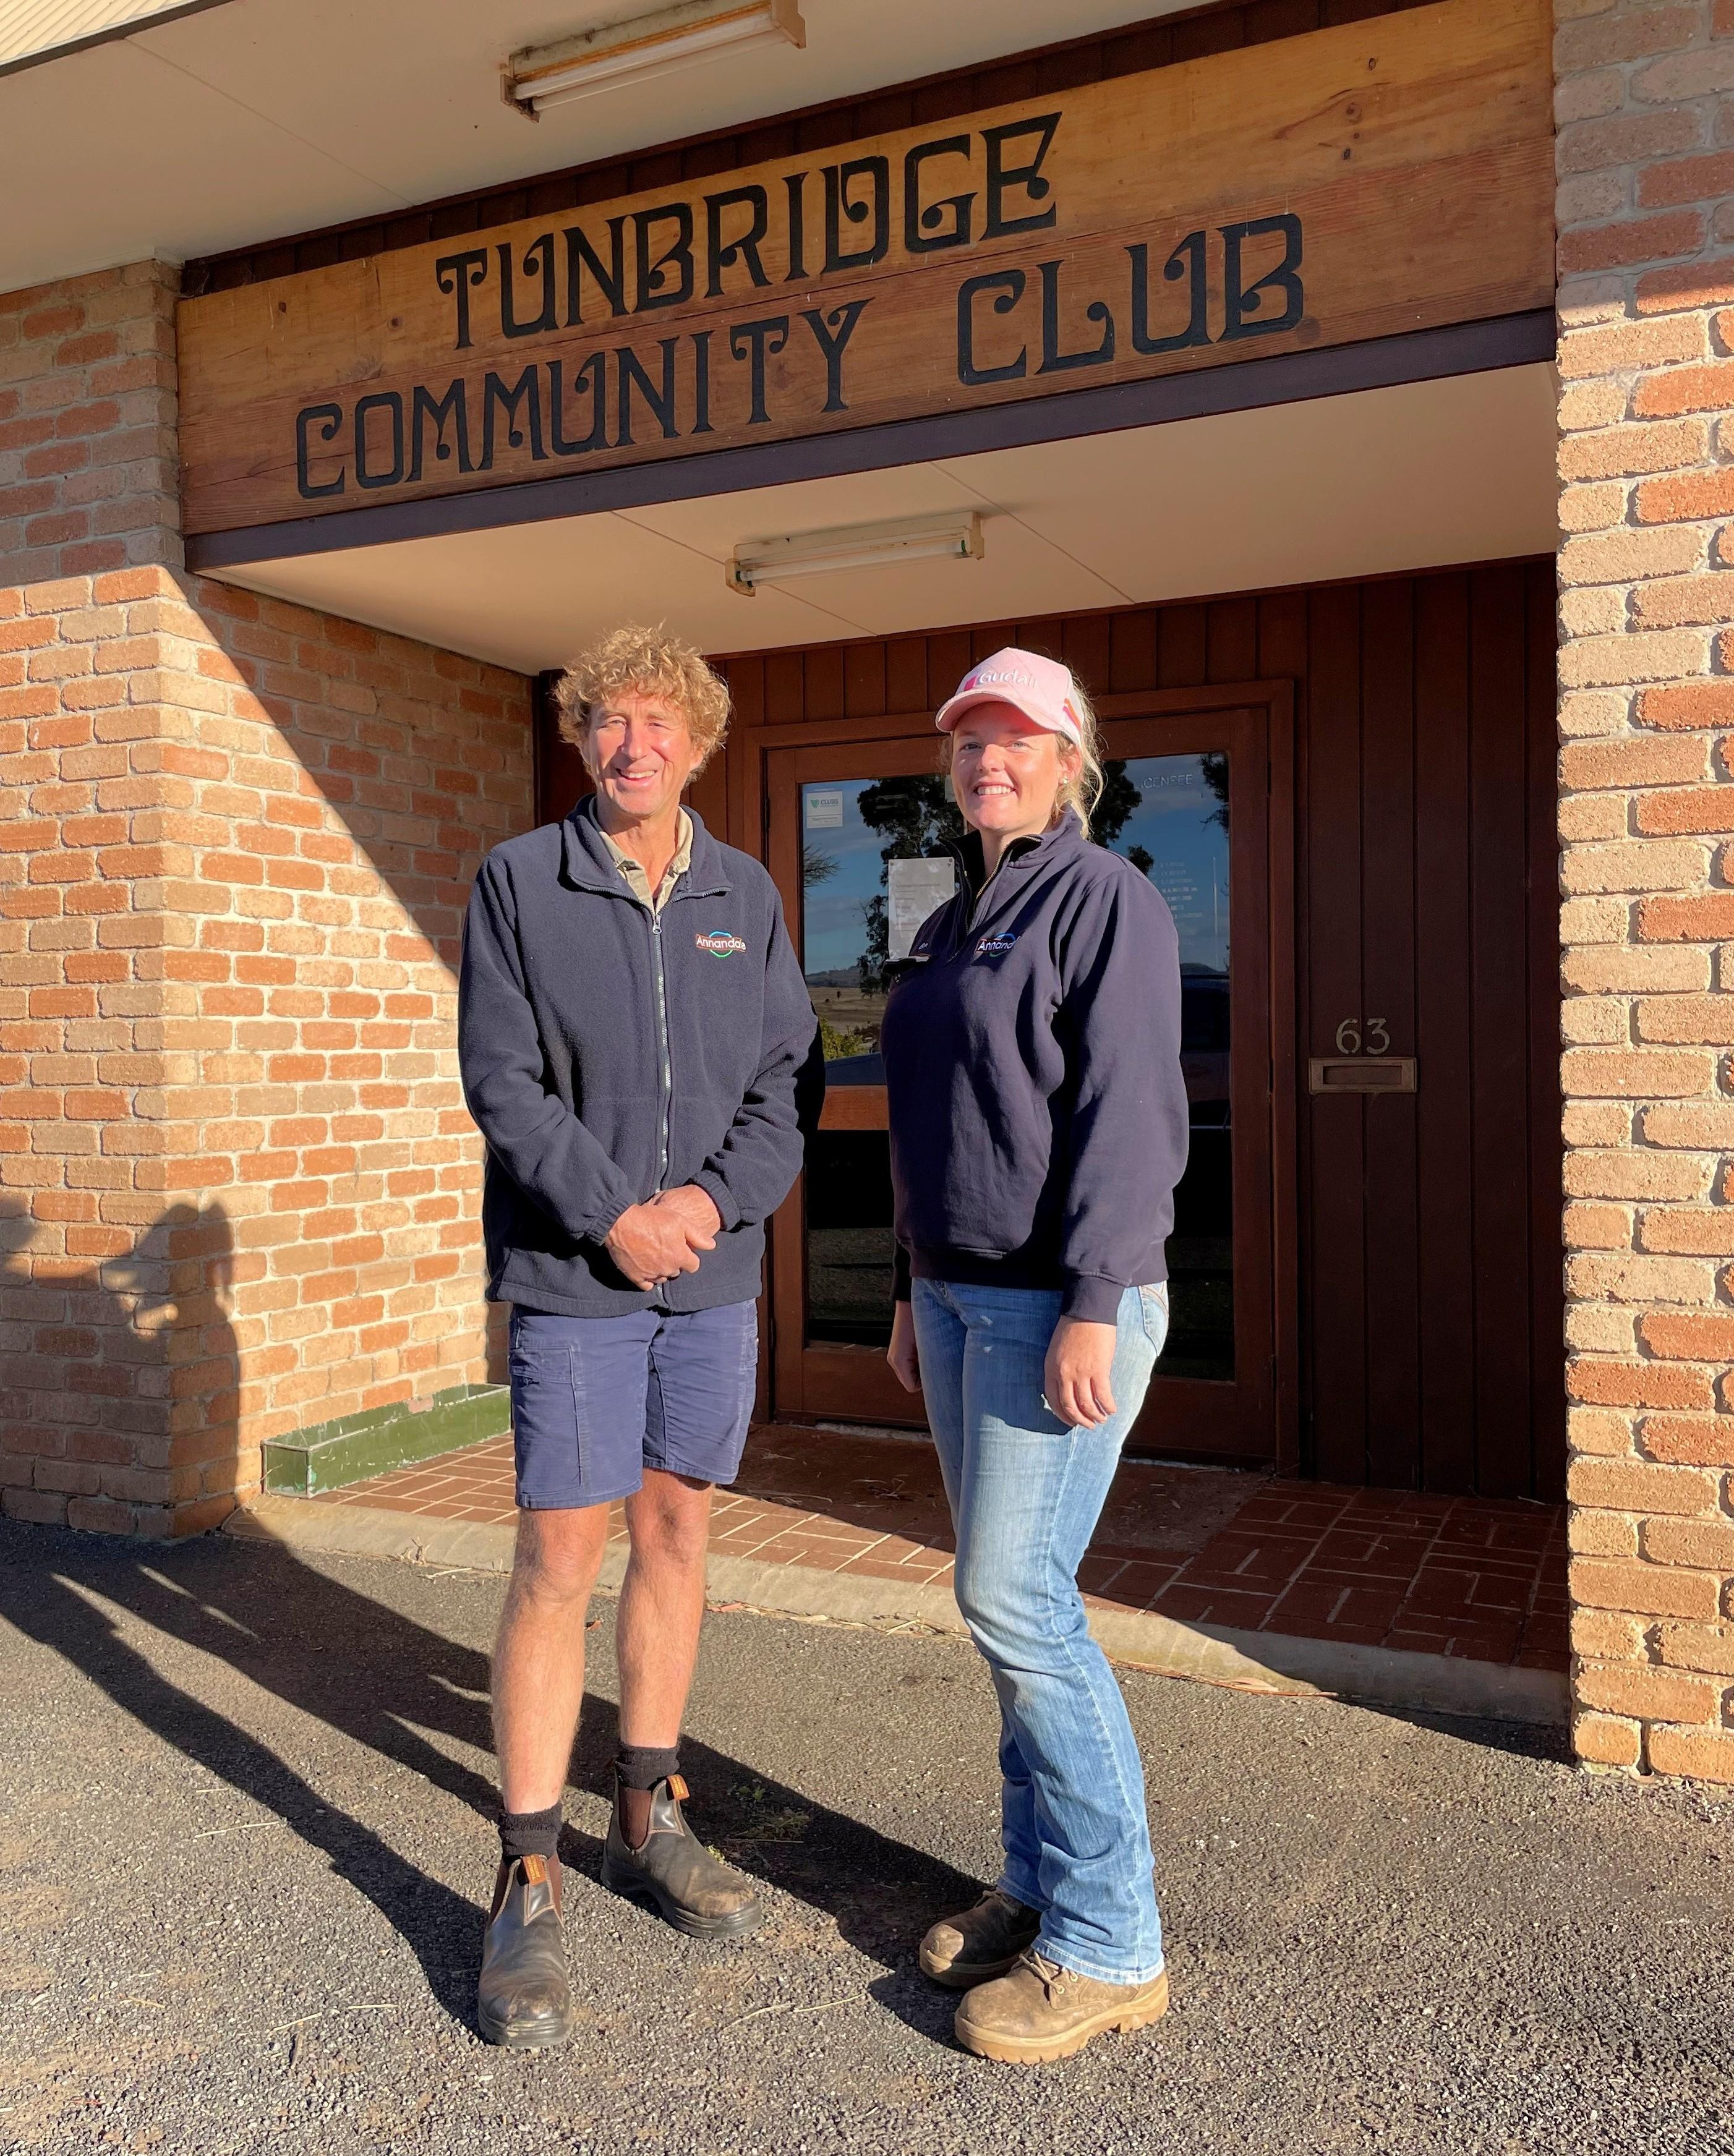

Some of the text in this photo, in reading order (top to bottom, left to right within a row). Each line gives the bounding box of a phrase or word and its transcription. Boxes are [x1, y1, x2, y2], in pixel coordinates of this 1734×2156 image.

[436, 111, 1062, 350] TUNBRIDGE
[296, 213, 1304, 500] COMMUNITY CLUB
[1336, 1017, 1390, 1055] 63
